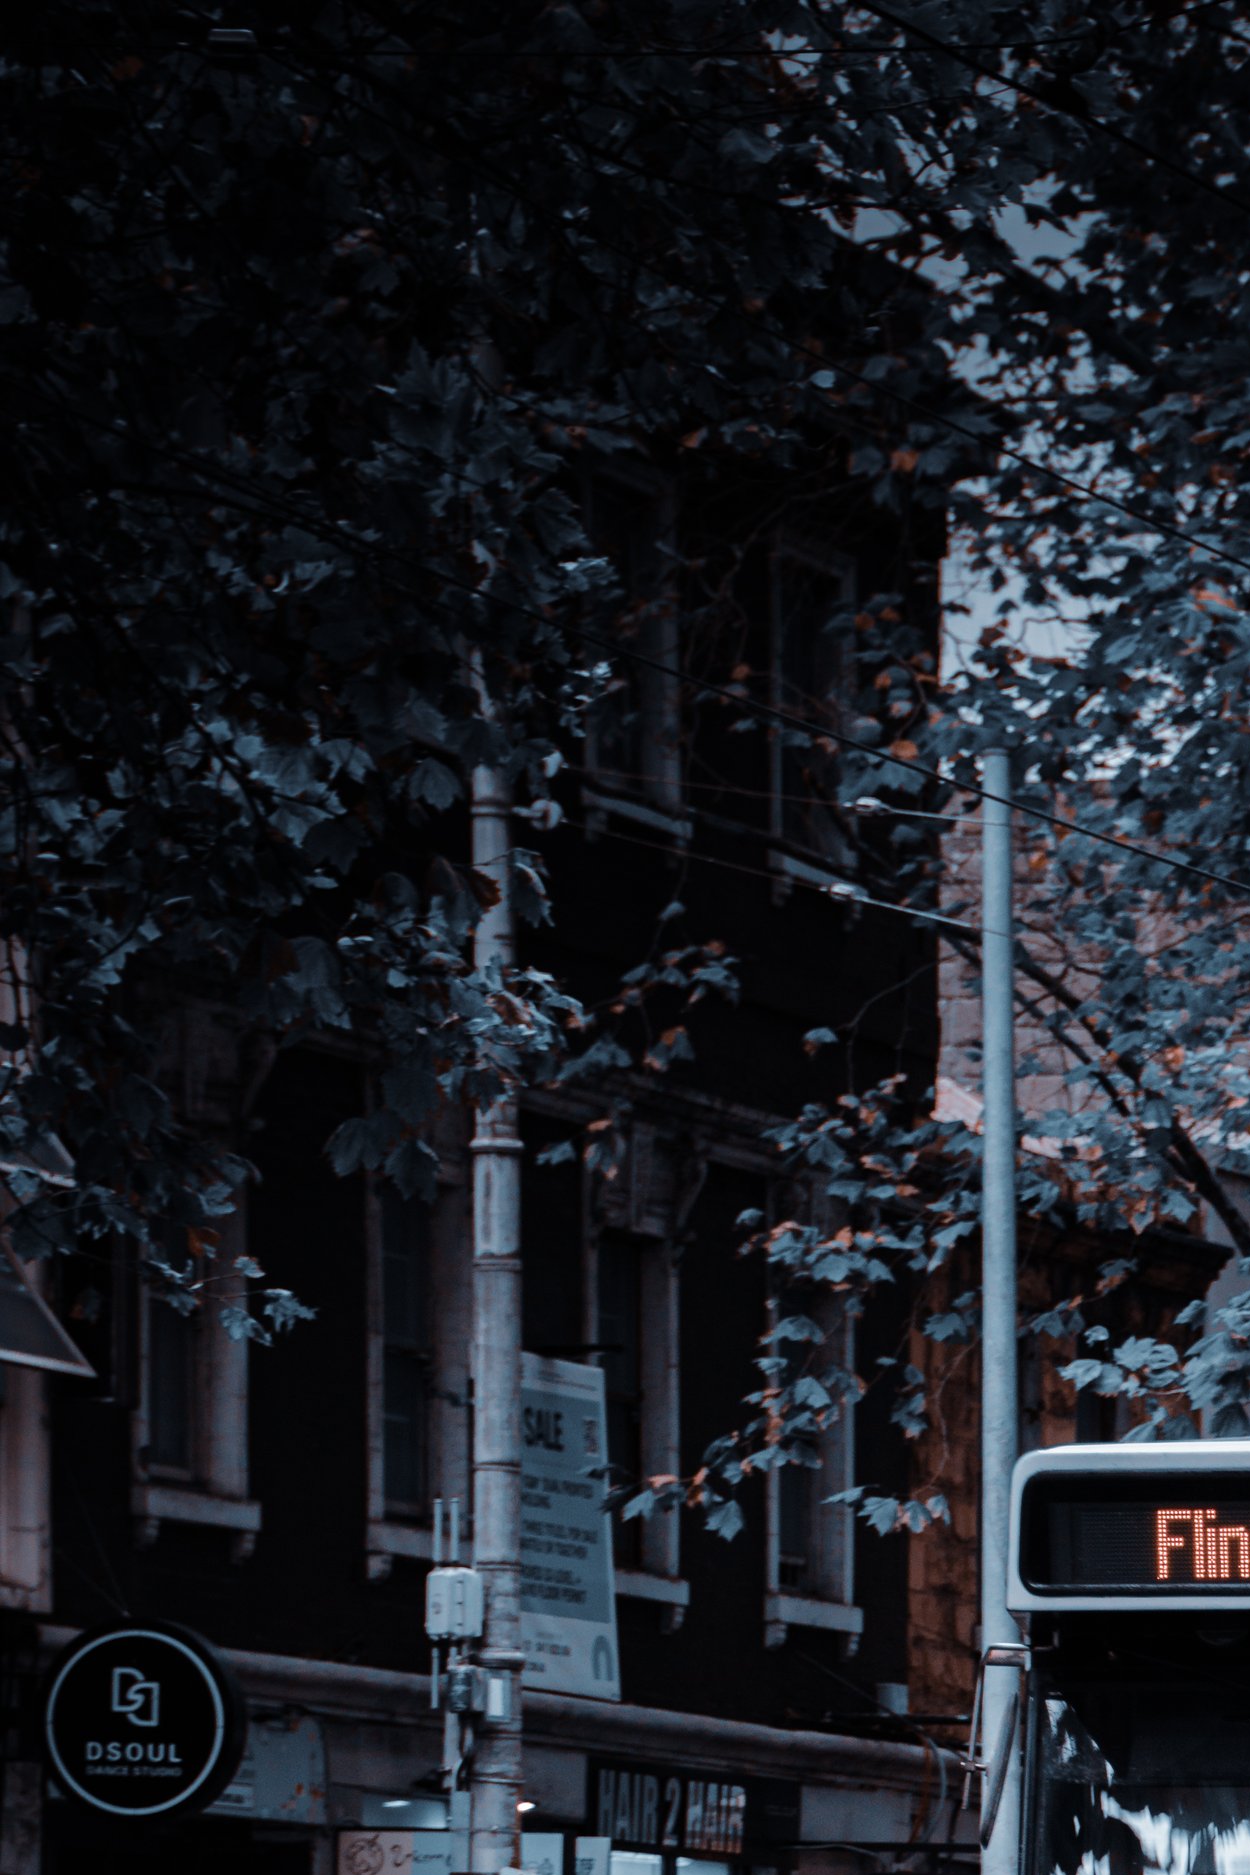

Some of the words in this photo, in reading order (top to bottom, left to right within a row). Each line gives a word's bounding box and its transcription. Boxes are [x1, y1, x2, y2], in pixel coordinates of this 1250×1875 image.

[523, 1407, 565, 1452] SALE
[84, 1740, 184, 1763] DSOUL
[598, 1768, 660, 1845] HAIR
[661, 1776, 684, 1848] 2
[684, 1780, 748, 1855] HAIR
